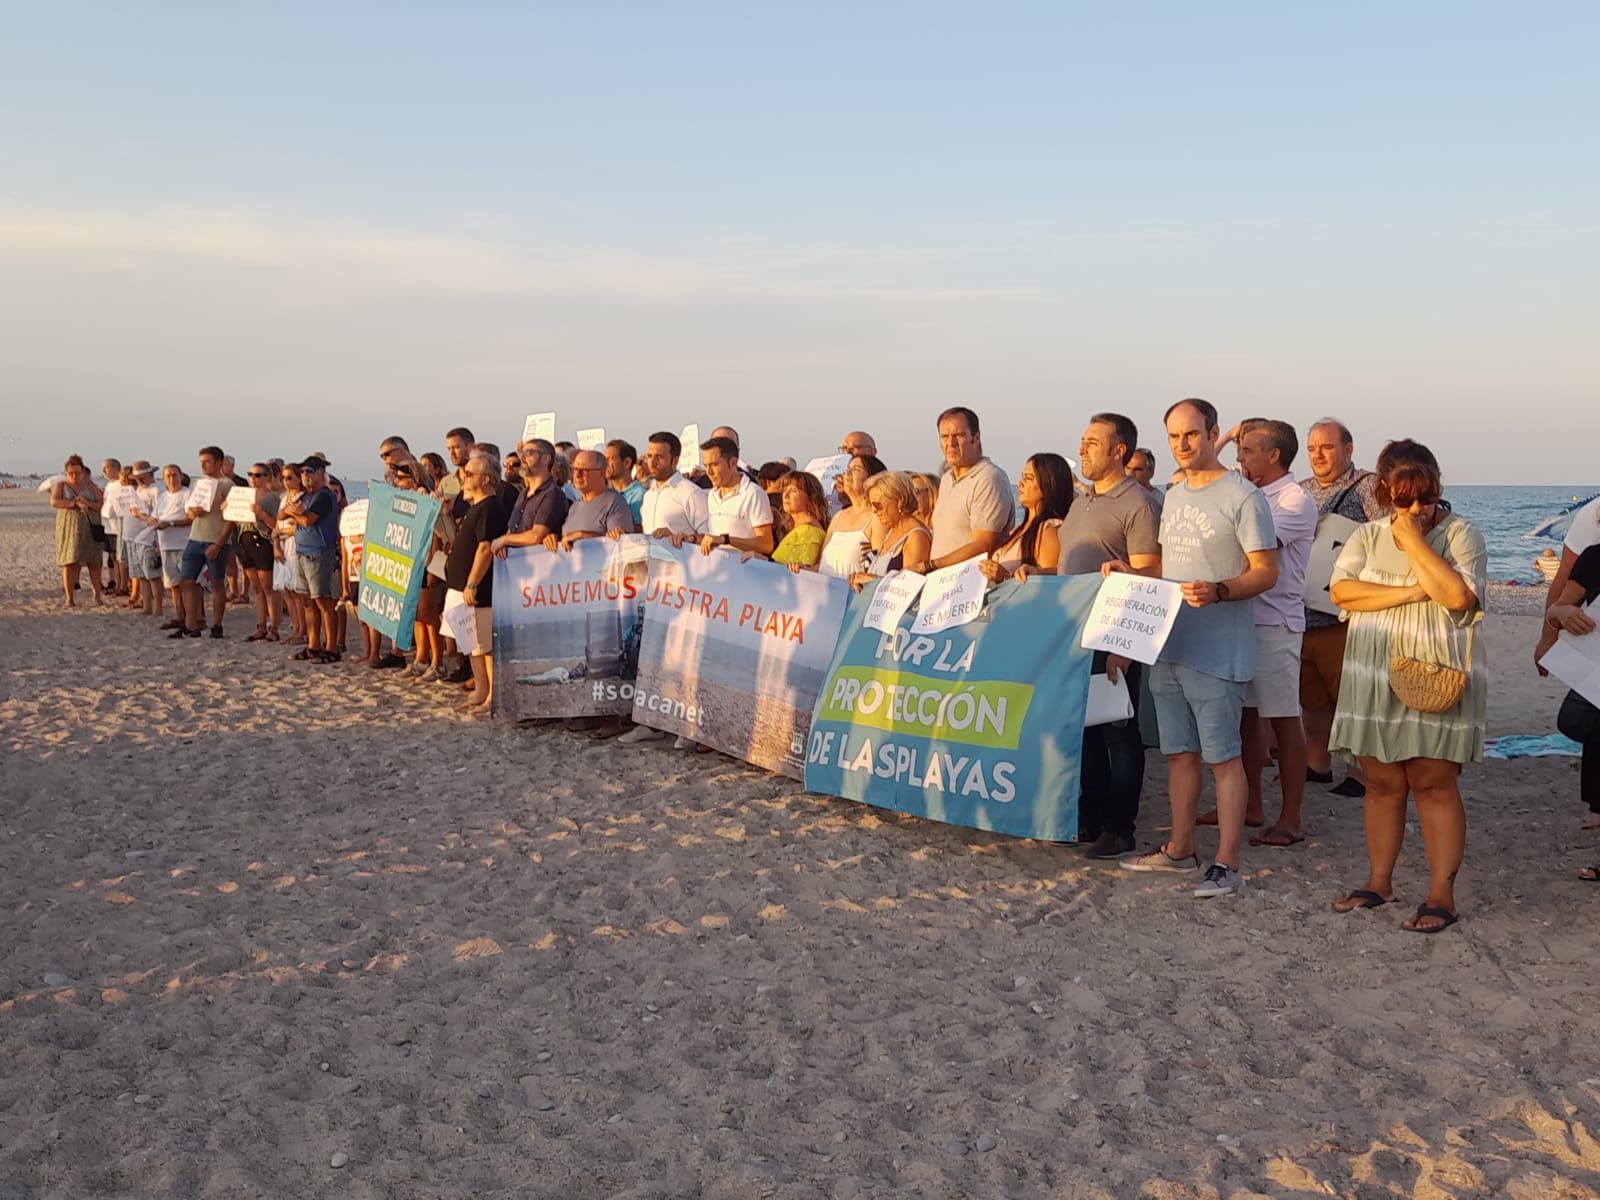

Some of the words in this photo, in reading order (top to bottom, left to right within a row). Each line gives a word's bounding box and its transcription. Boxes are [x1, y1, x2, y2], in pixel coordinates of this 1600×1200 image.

[1183, 504, 1216, 539] GOODS
[1126, 580, 1144, 592] POR
[1146, 583, 1158, 595] LA
[522, 575, 638, 608] SALVEMOS
[646, 579, 730, 624] UESTRA
[738, 603, 804, 645] PLAYA
[922, 613, 935, 626] SE
[937, 600, 980, 623] MUEREN
[1104, 596, 1168, 618] REGENERACIÓN
[1100, 614, 1111, 625] DE
[1111, 616, 1157, 636] NUESTRAS
[874, 627, 935, 666] POR
[933, 639, 976, 673] LA
[829, 678, 1008, 737] PROTECCIÓN
[808, 730, 836, 765] DE
